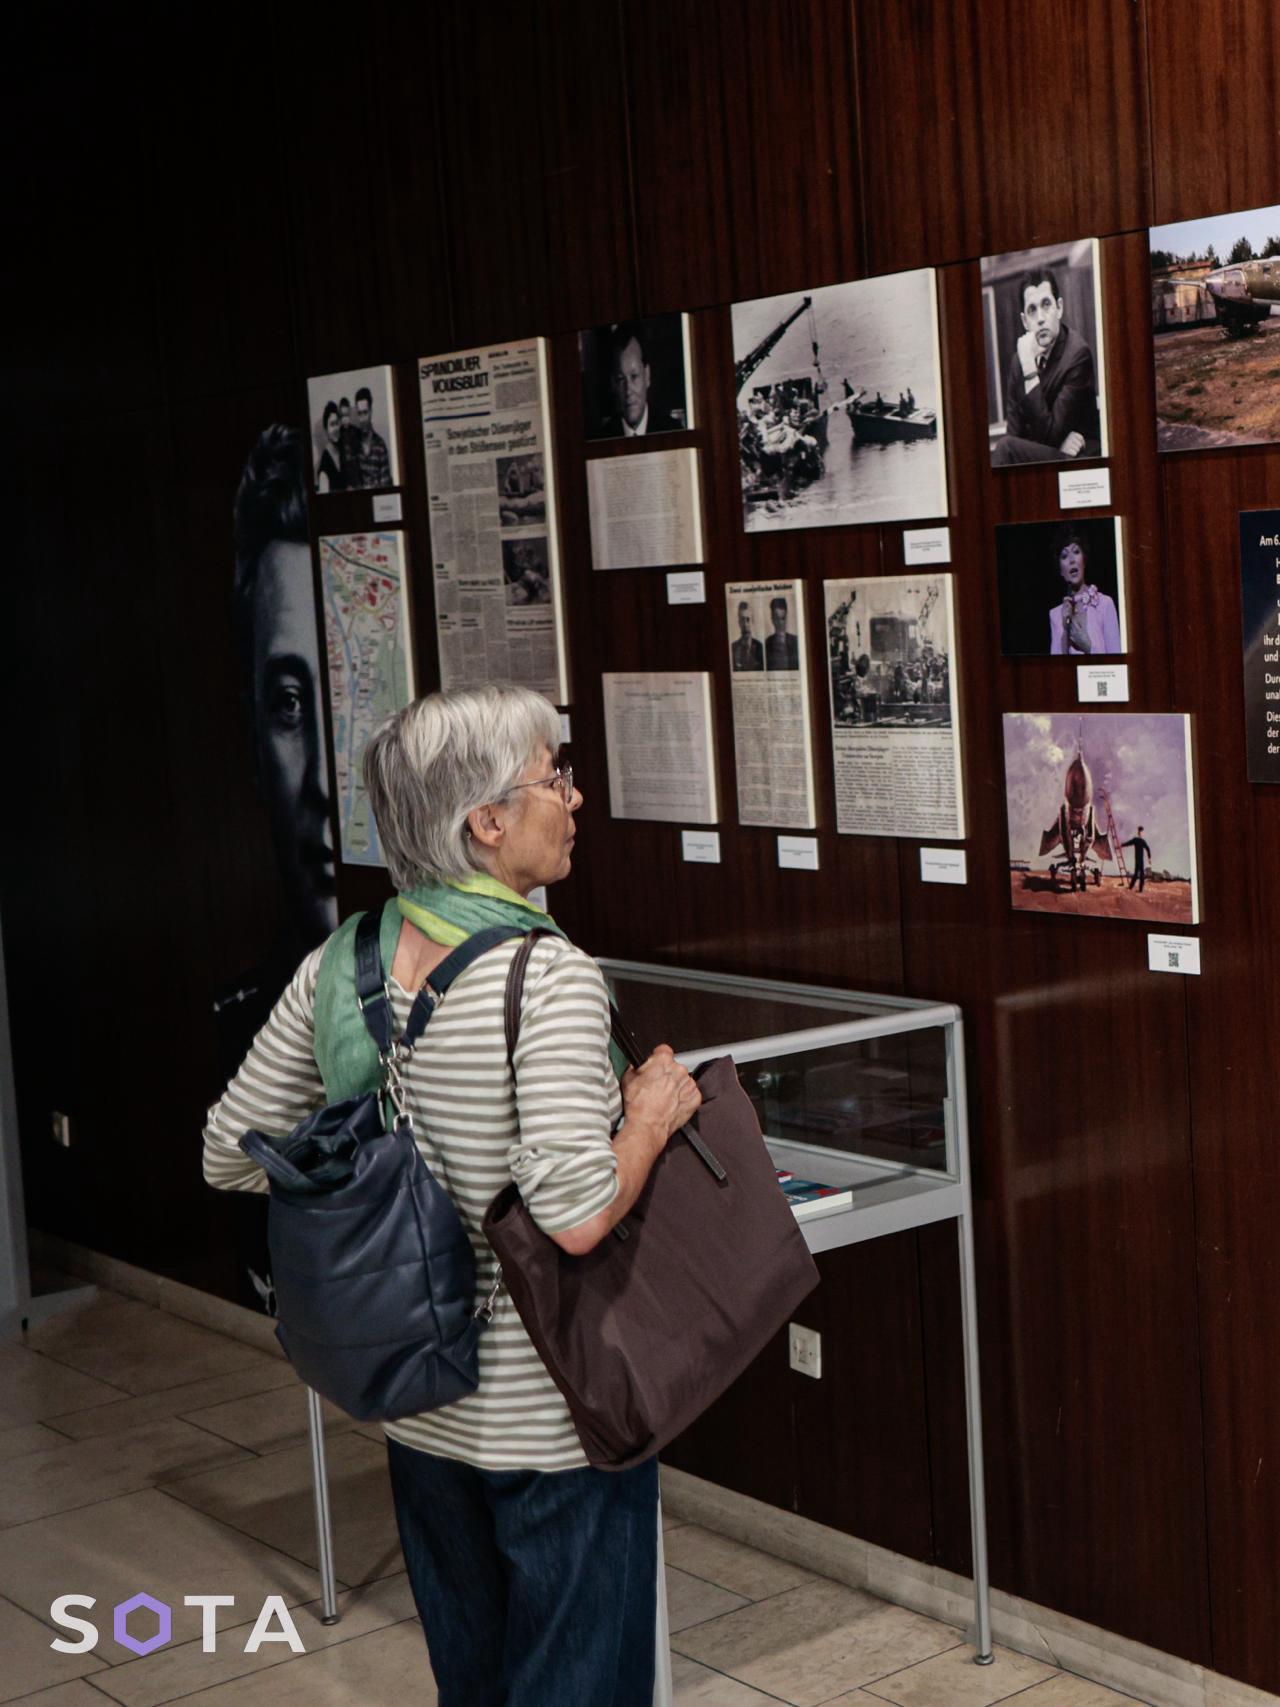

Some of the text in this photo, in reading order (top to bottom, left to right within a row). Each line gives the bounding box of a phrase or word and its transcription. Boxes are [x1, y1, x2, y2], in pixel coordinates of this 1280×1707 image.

[1259, 535, 1273, 546] Am
[1274, 534, 1280, 545] 6.
[1263, 634, 1273, 646] ihr
[1264, 650, 1278, 662] und
[1267, 726, 1279, 738] der
[1267, 742, 1280, 754] der
